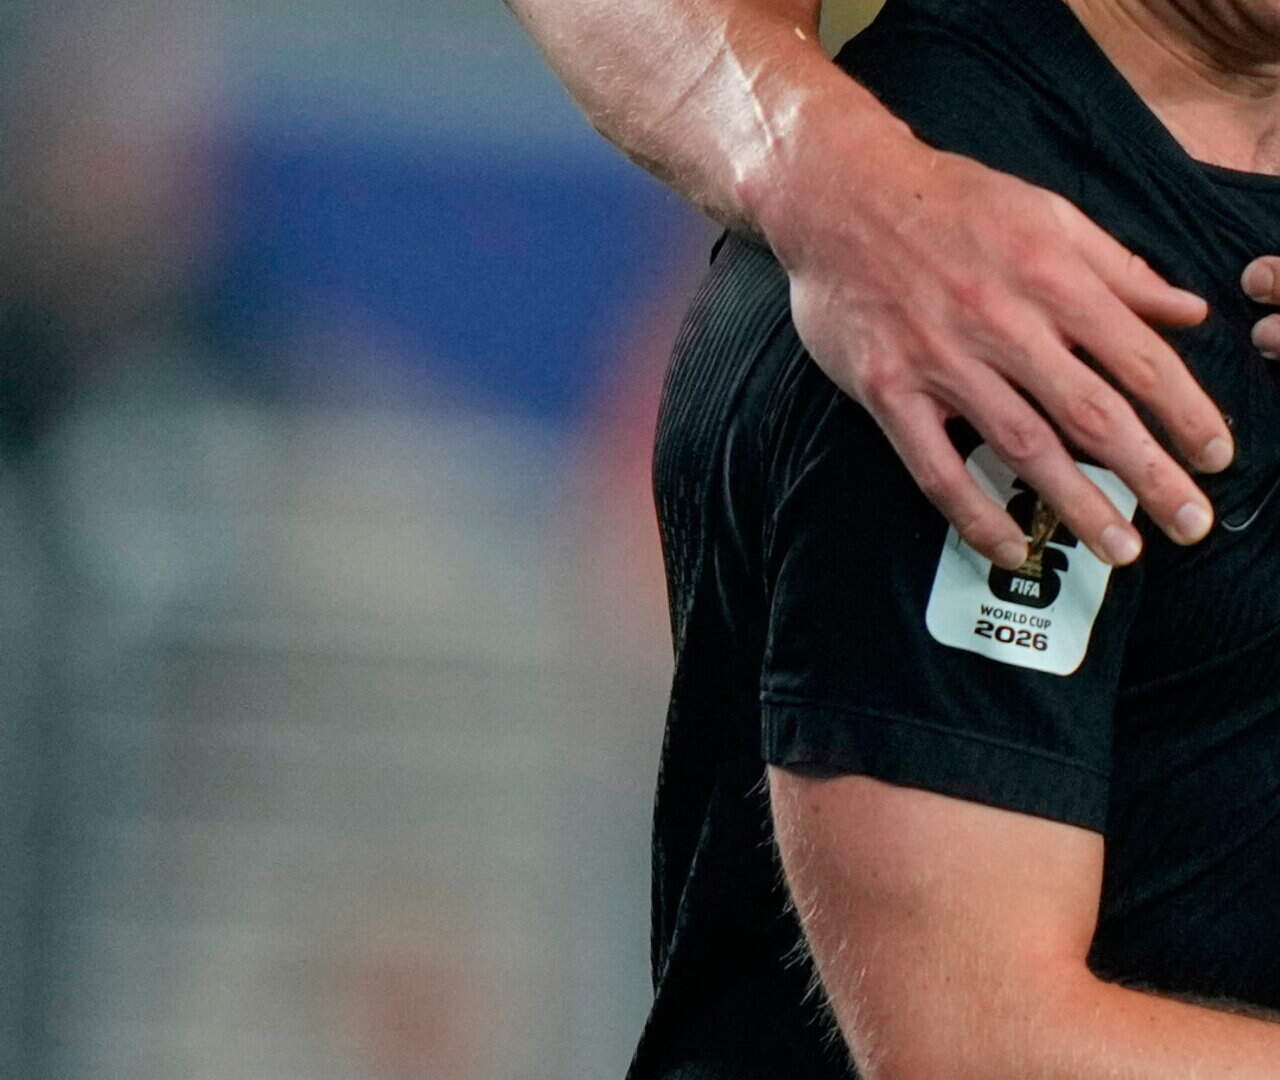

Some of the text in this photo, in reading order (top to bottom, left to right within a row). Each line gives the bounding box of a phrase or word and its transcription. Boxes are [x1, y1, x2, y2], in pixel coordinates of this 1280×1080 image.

[1010, 577, 1041, 598] FIFA
[980, 604, 1052, 630] WORLD CUP
[974, 618, 1048, 651] 2026
